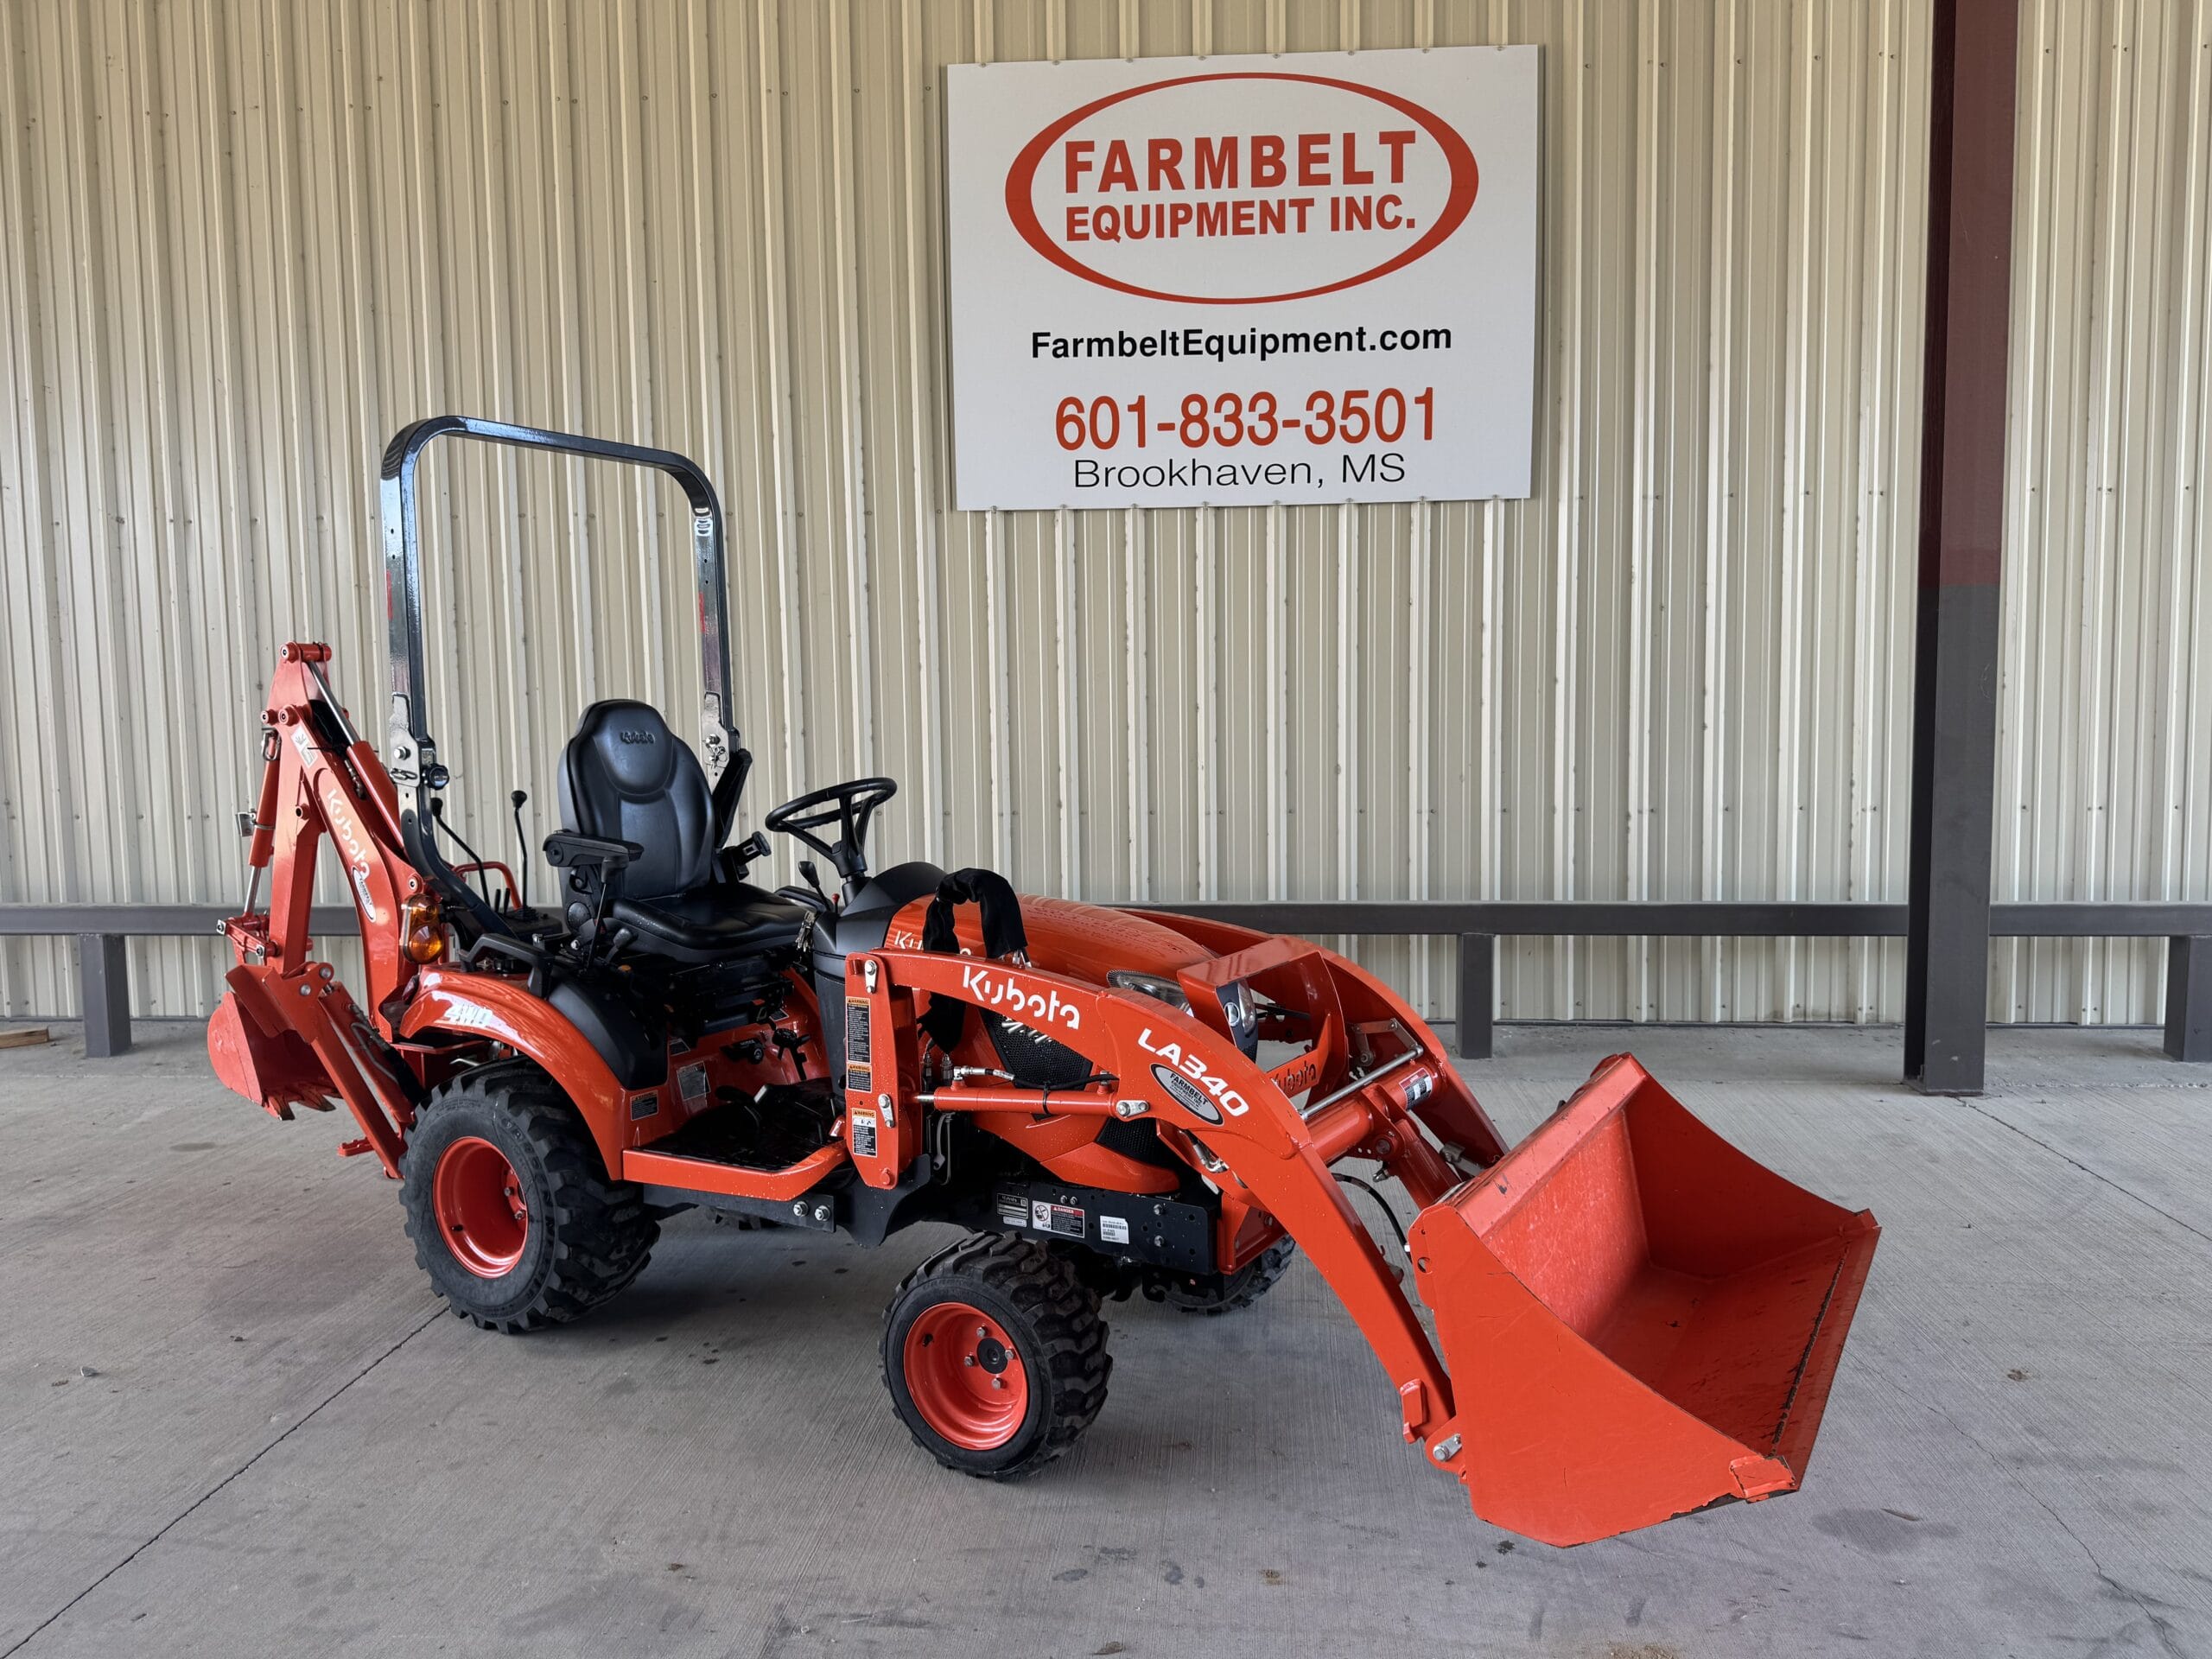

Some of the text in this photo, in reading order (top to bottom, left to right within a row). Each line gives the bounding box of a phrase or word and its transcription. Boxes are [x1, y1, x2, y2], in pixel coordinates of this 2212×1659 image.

[1065, 130, 1416, 194] FARMBELT
[1066, 194, 1415, 243] EQUIPMENT INC.
[1032, 325, 1452, 363] FarmbeltEquipment.com
[1055, 386, 1433, 451] 601-833-3501
[1075, 453, 1405, 490] Brookhaven, MS
[327, 789, 371, 881] Kubota
[962, 964, 1080, 1031] Kubota
[1137, 1027, 1249, 1117] LA340
[1169, 1072, 1209, 1105] FARMBELT
